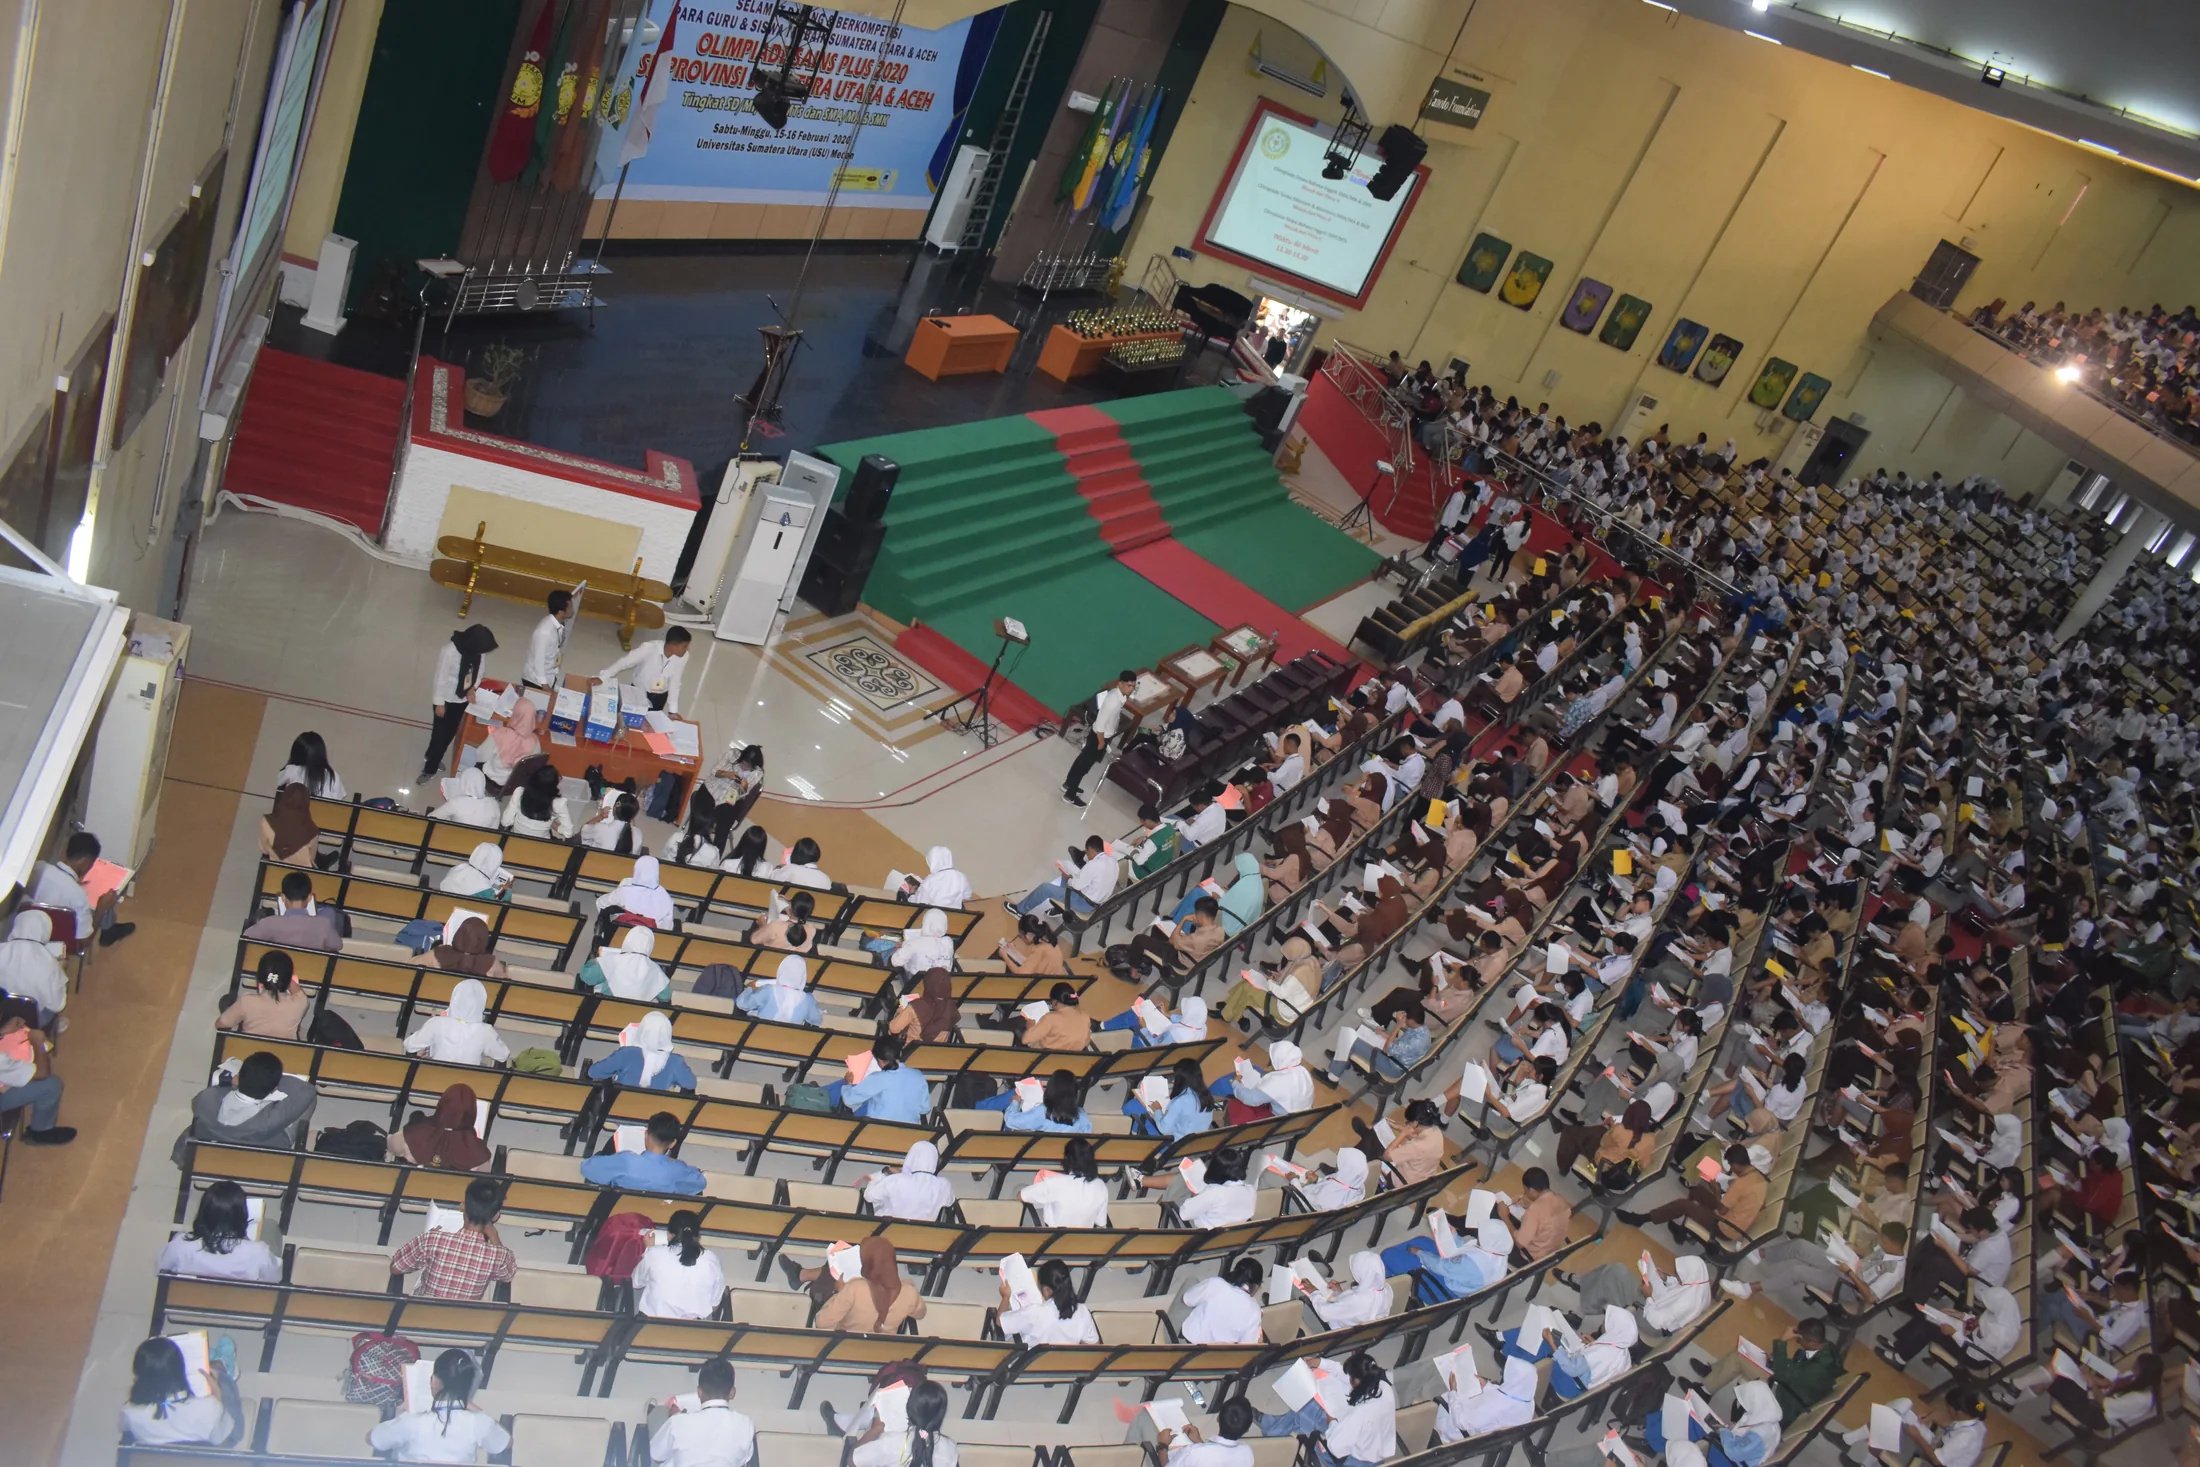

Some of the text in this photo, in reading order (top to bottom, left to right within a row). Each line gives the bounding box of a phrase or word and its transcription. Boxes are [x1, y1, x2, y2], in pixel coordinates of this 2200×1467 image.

[706, 11, 736, 29] GURU
[739, 17, 749, 31] &
[829, 33, 877, 52] SUMATERA
[907, 47, 914, 59] &
[915, 49, 939, 63] ACEH
[835, 54, 876, 79] PLUS
[873, 59, 910, 85] 2020
[682, 91, 725, 112] Tingkat
[803, 104, 823, 120] dan
[868, 112, 891, 128] SMK
[884, 86, 897, 107] &
[895, 88, 936, 113] ACEH
[1428, 88, 1481, 119] Tanoto Foundation
[696, 137, 746, 153] Universitas
[746, 142, 786, 156] Sumatera
[786, 145, 809, 157] Utara
[808, 147, 830, 160] (USU)
[712, 122, 853, 146] Sabtu-Minggu, 15-16 Februari 2020
